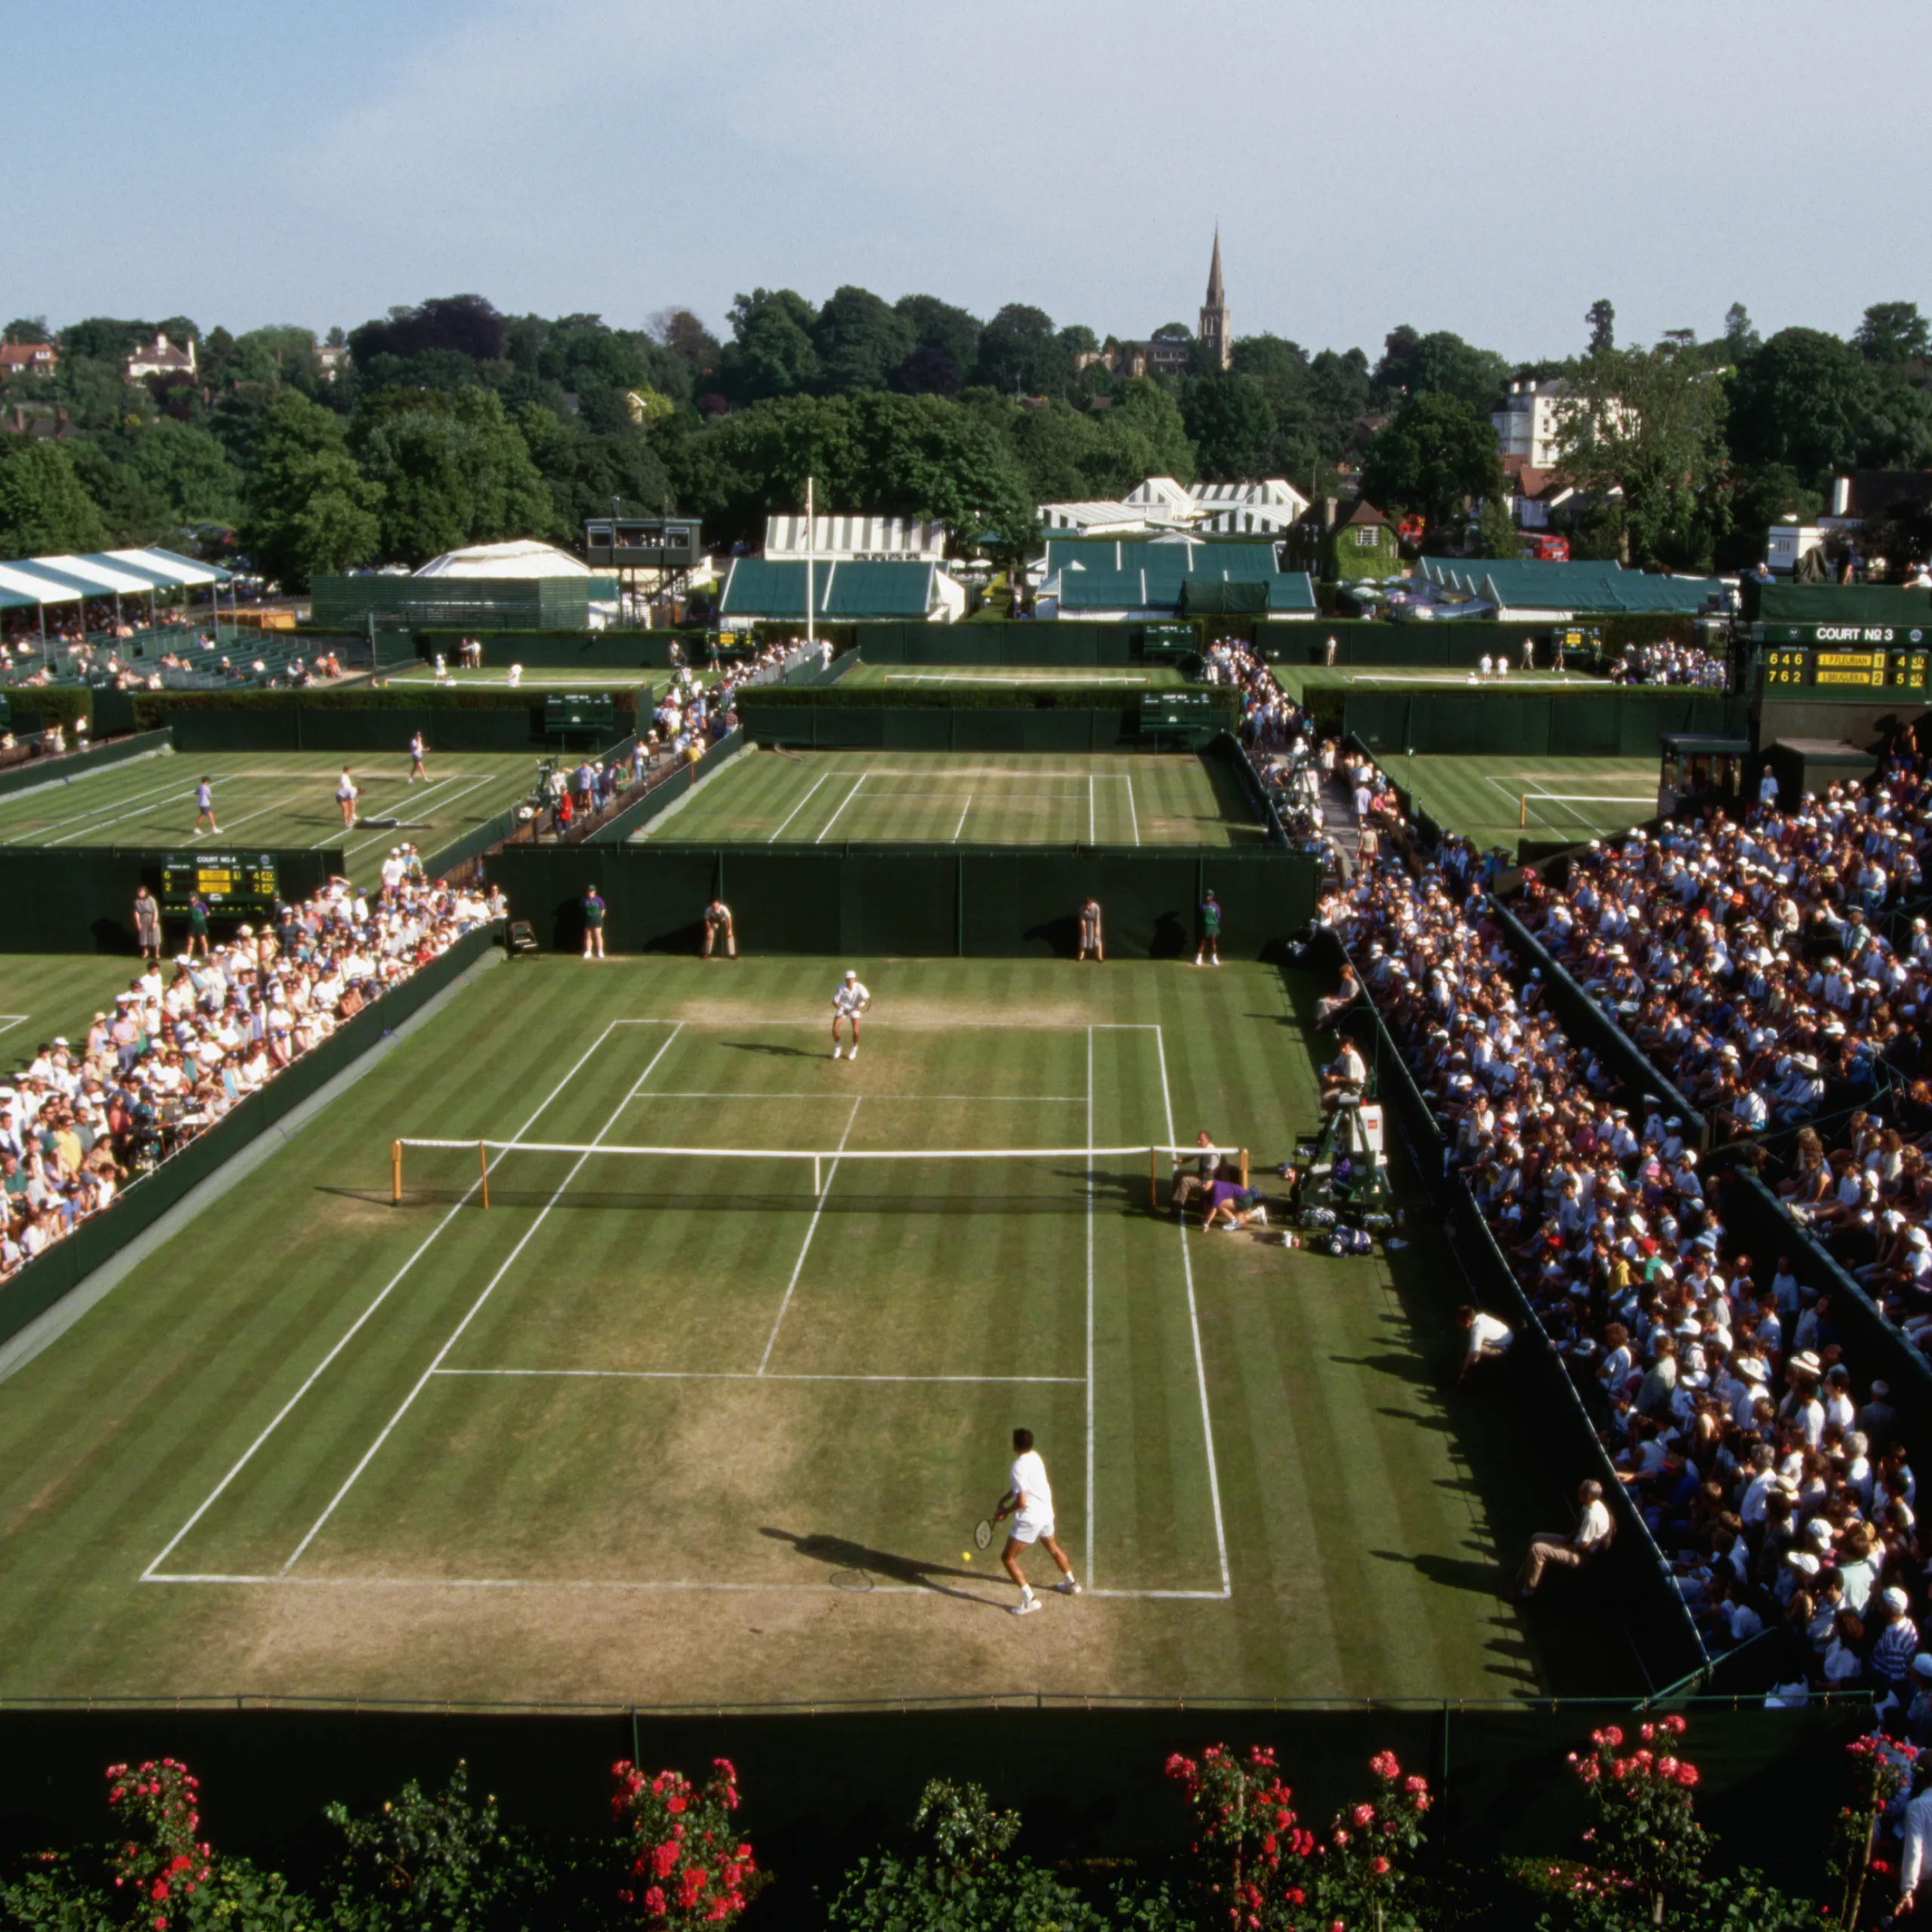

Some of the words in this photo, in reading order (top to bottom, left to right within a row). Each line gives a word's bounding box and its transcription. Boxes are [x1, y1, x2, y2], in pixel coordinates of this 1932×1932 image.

[1817, 628, 1860, 641] COURT
[1884, 628, 1894, 641] 3
[1770, 653, 1778, 665] 6
[1782, 653, 1790, 665] 4
[1794, 654, 1803, 665] 6
[1897, 655, 1906, 667] 4
[1769, 671, 1777, 682] 7
[1780, 671, 1789, 682] 6
[1793, 671, 1801, 683] 2
[1896, 672, 1904, 685] 5
[164, 871, 171, 879] 6
[253, 872, 260, 880] 4
[165, 883, 172, 891] 2
[254, 884, 260, 892] 2
